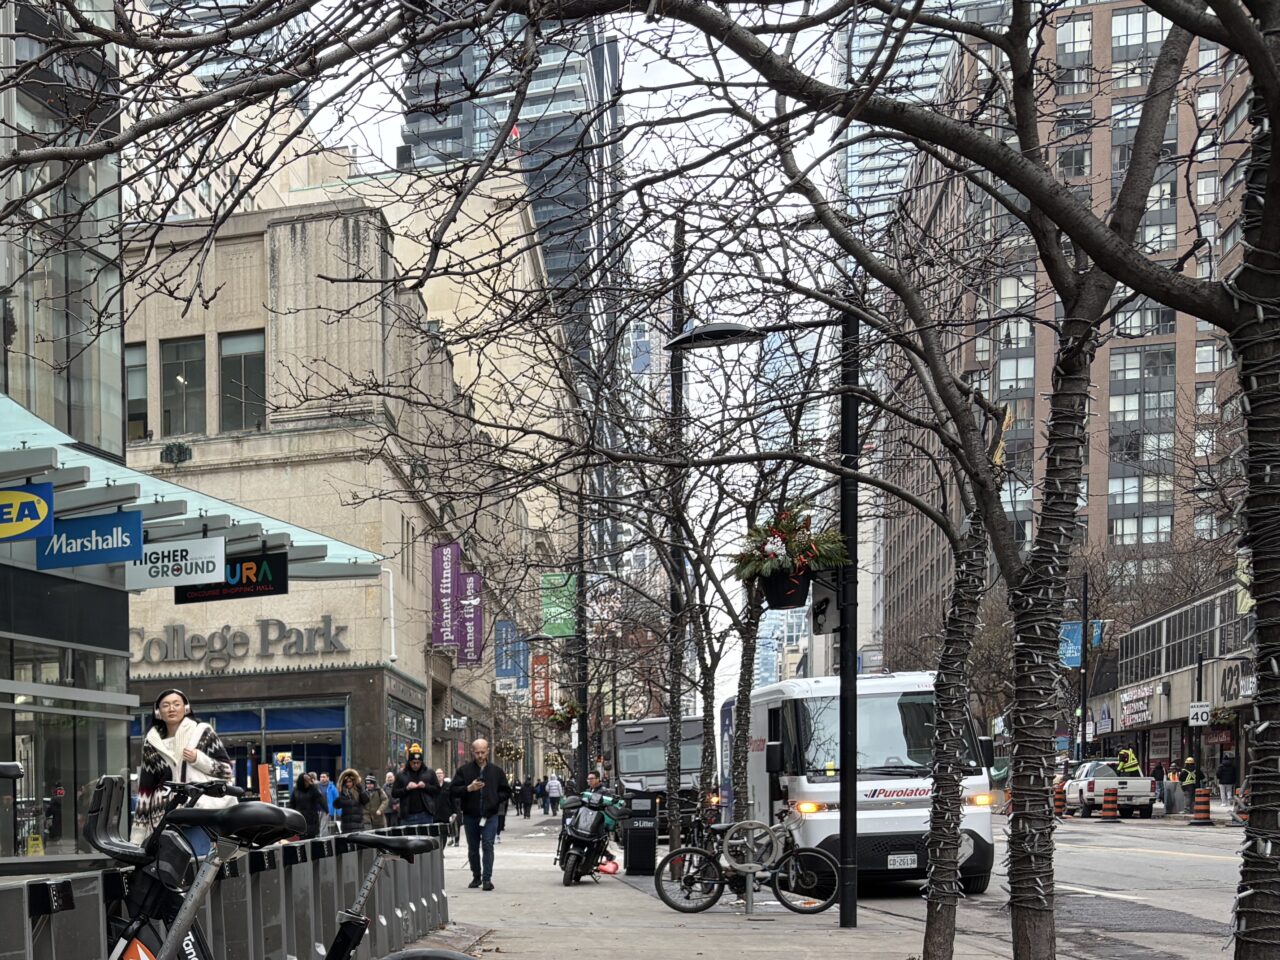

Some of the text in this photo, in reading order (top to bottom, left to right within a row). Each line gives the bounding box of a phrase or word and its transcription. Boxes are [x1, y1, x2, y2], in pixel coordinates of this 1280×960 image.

[44, 526, 131, 556] Marshalls
[148, 560, 216, 579] GROUND
[225, 559, 273, 586] URA
[440, 547, 455, 642] planet fitness
[129, 614, 351, 669] College Park
[1221, 663, 1240, 703] 423
[1191, 711, 1210, 722] 40
[876, 787, 932, 799] Purolator
